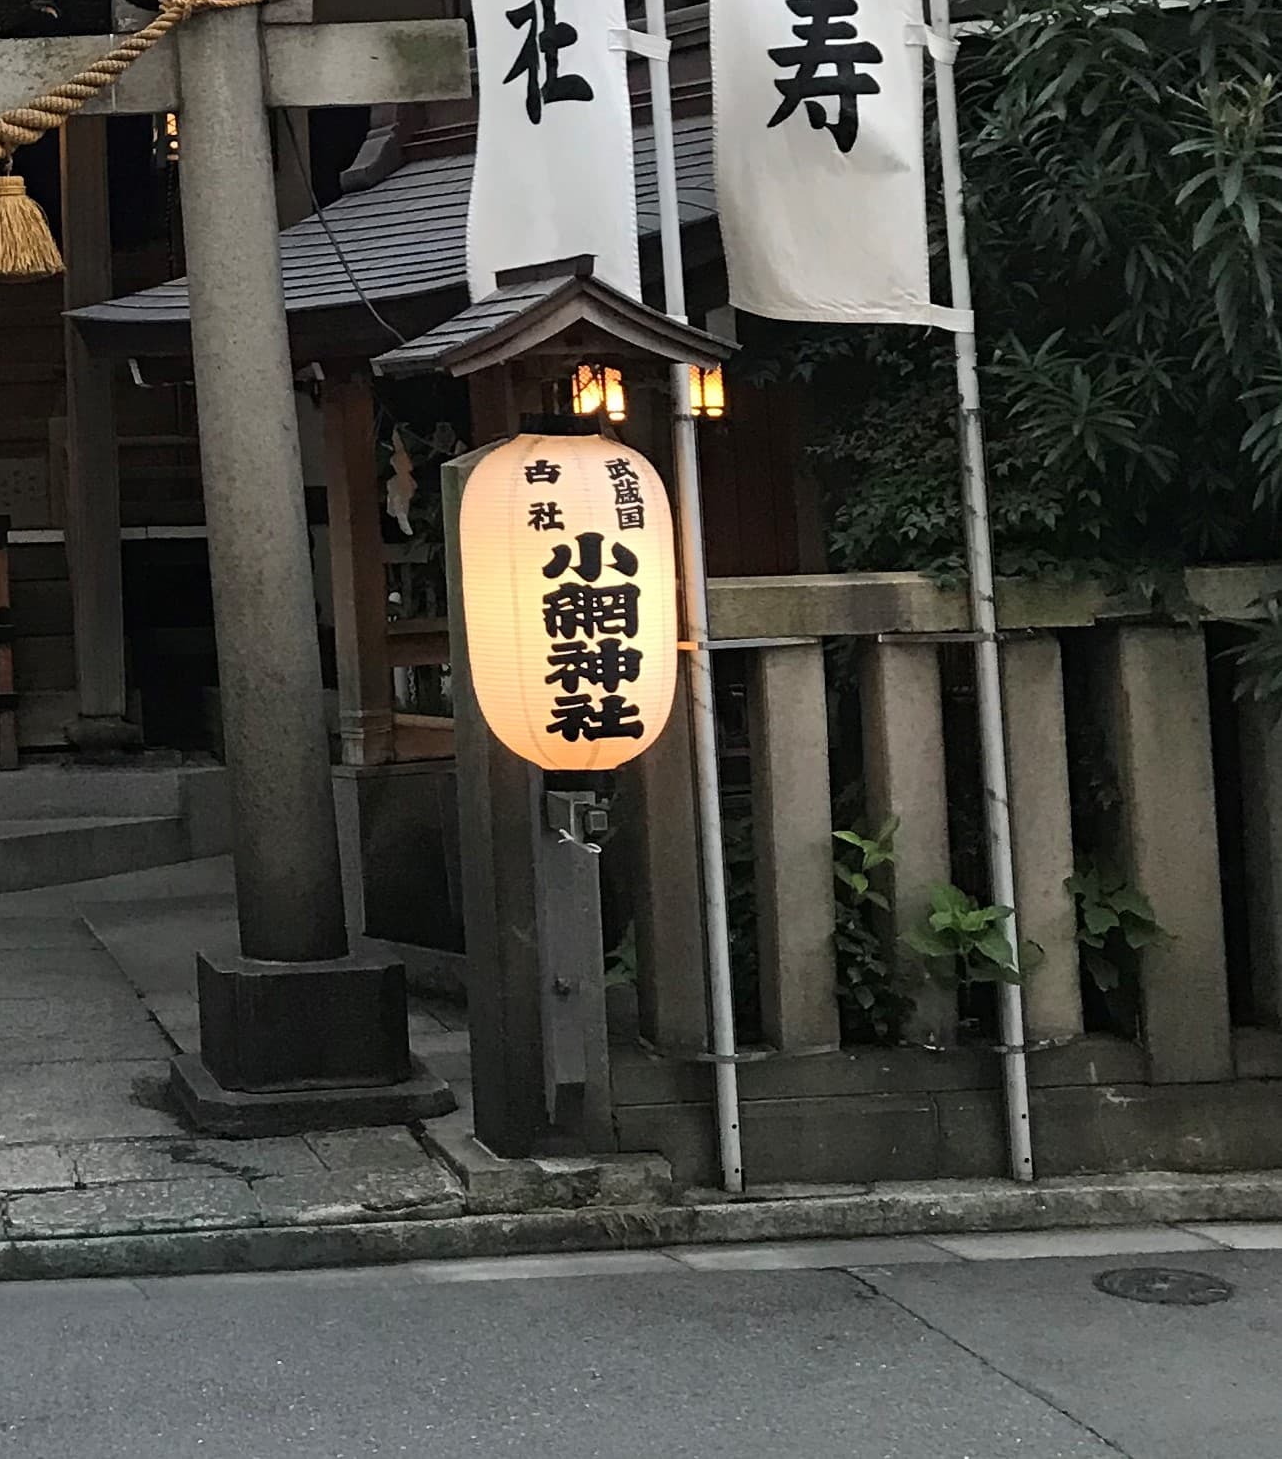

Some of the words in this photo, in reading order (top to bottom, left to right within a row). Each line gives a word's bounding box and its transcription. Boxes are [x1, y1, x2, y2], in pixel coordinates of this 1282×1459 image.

[524, 459, 565, 531] 古社
[605, 458, 645, 530] 武蔵国
[542, 532, 645, 742] 小網神社
